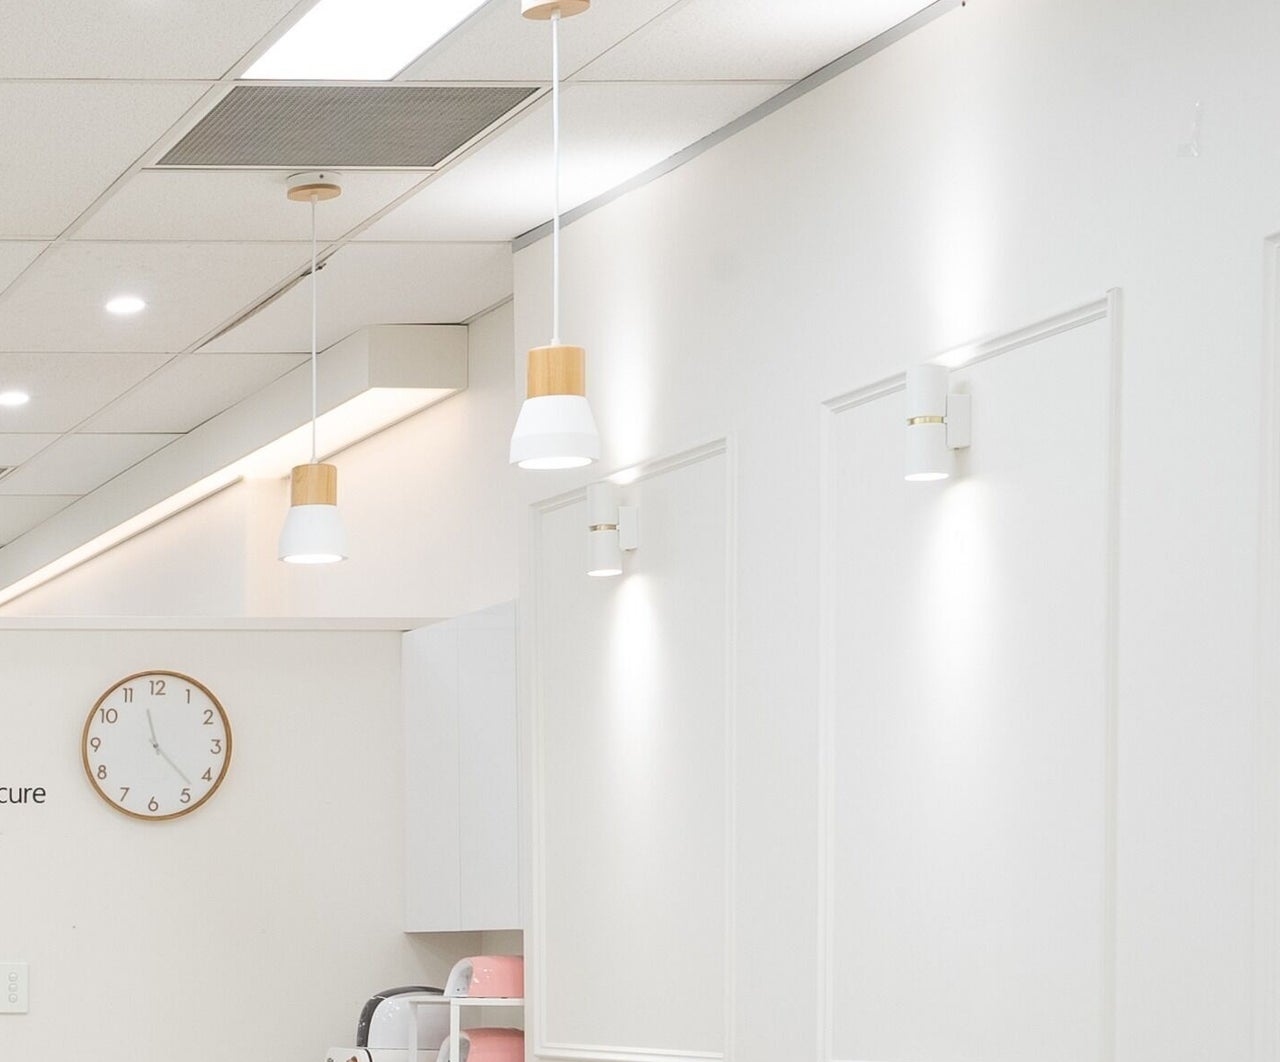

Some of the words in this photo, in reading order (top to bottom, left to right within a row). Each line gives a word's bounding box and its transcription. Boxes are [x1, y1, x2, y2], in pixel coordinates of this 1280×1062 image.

[123, 687, 134, 703] 11
[149, 680, 166, 696] 12
[185, 689, 191, 704] 1
[99, 708, 118, 724] 10
[203, 709, 214, 725] 2
[90, 737, 101, 752] 9
[210, 739, 222, 754] 3
[97, 765, 107, 780] 8
[201, 767, 213, 782] 4
[119, 787, 130, 802] 7
[179, 788, 191, 803] 5
[147, 796, 159, 812] 6
